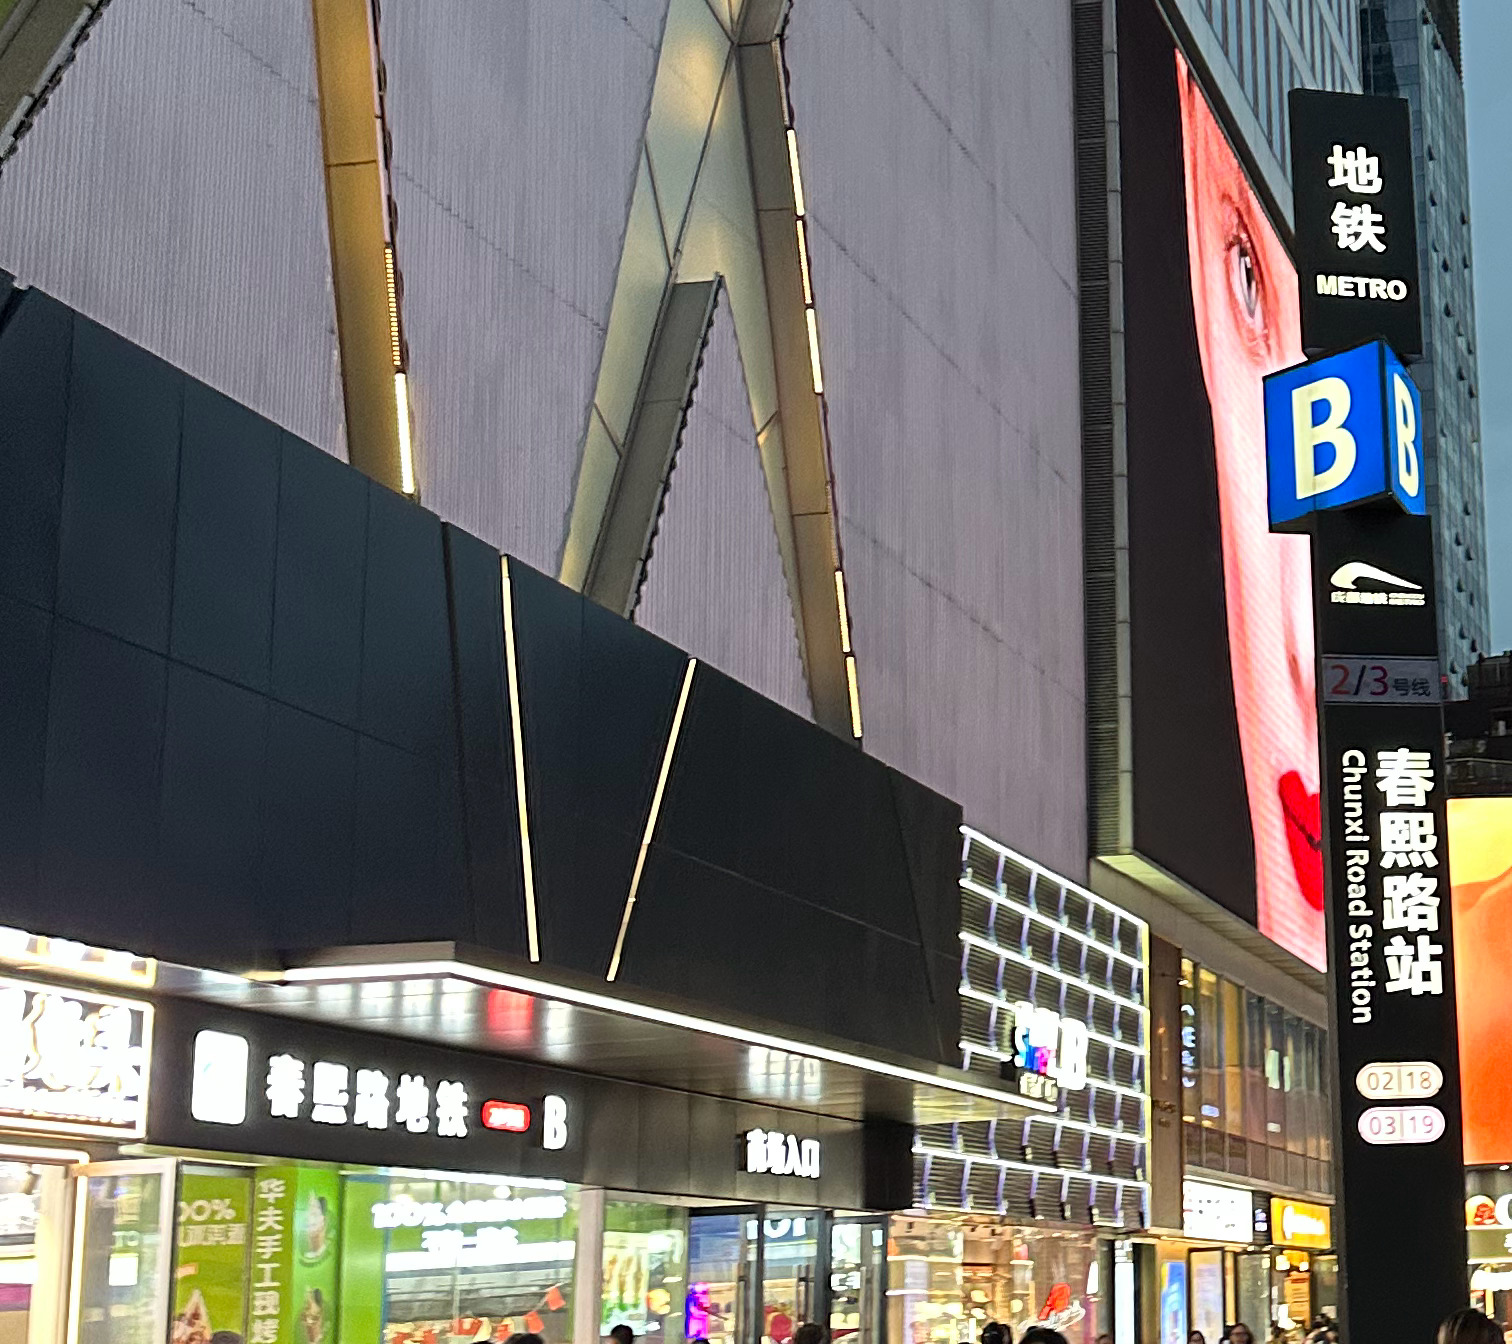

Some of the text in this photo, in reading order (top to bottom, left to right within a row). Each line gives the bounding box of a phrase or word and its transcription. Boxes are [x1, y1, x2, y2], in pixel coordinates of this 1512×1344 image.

[1326, 144, 1387, 253] 地铁
[1316, 274, 1408, 301] METRO
[1291, 376, 1358, 501] B
[1393, 370, 1421, 499] B
[1330, 663, 1432, 697] 2/3号线
[1341, 748, 1377, 1025] Chunxi Road Station
[1375, 747, 1444, 996] 春熙路站
[1366, 1070, 1432, 1091] 02 18
[542, 1094, 568, 1150] B
[1369, 1115, 1434, 1136] 03 19
